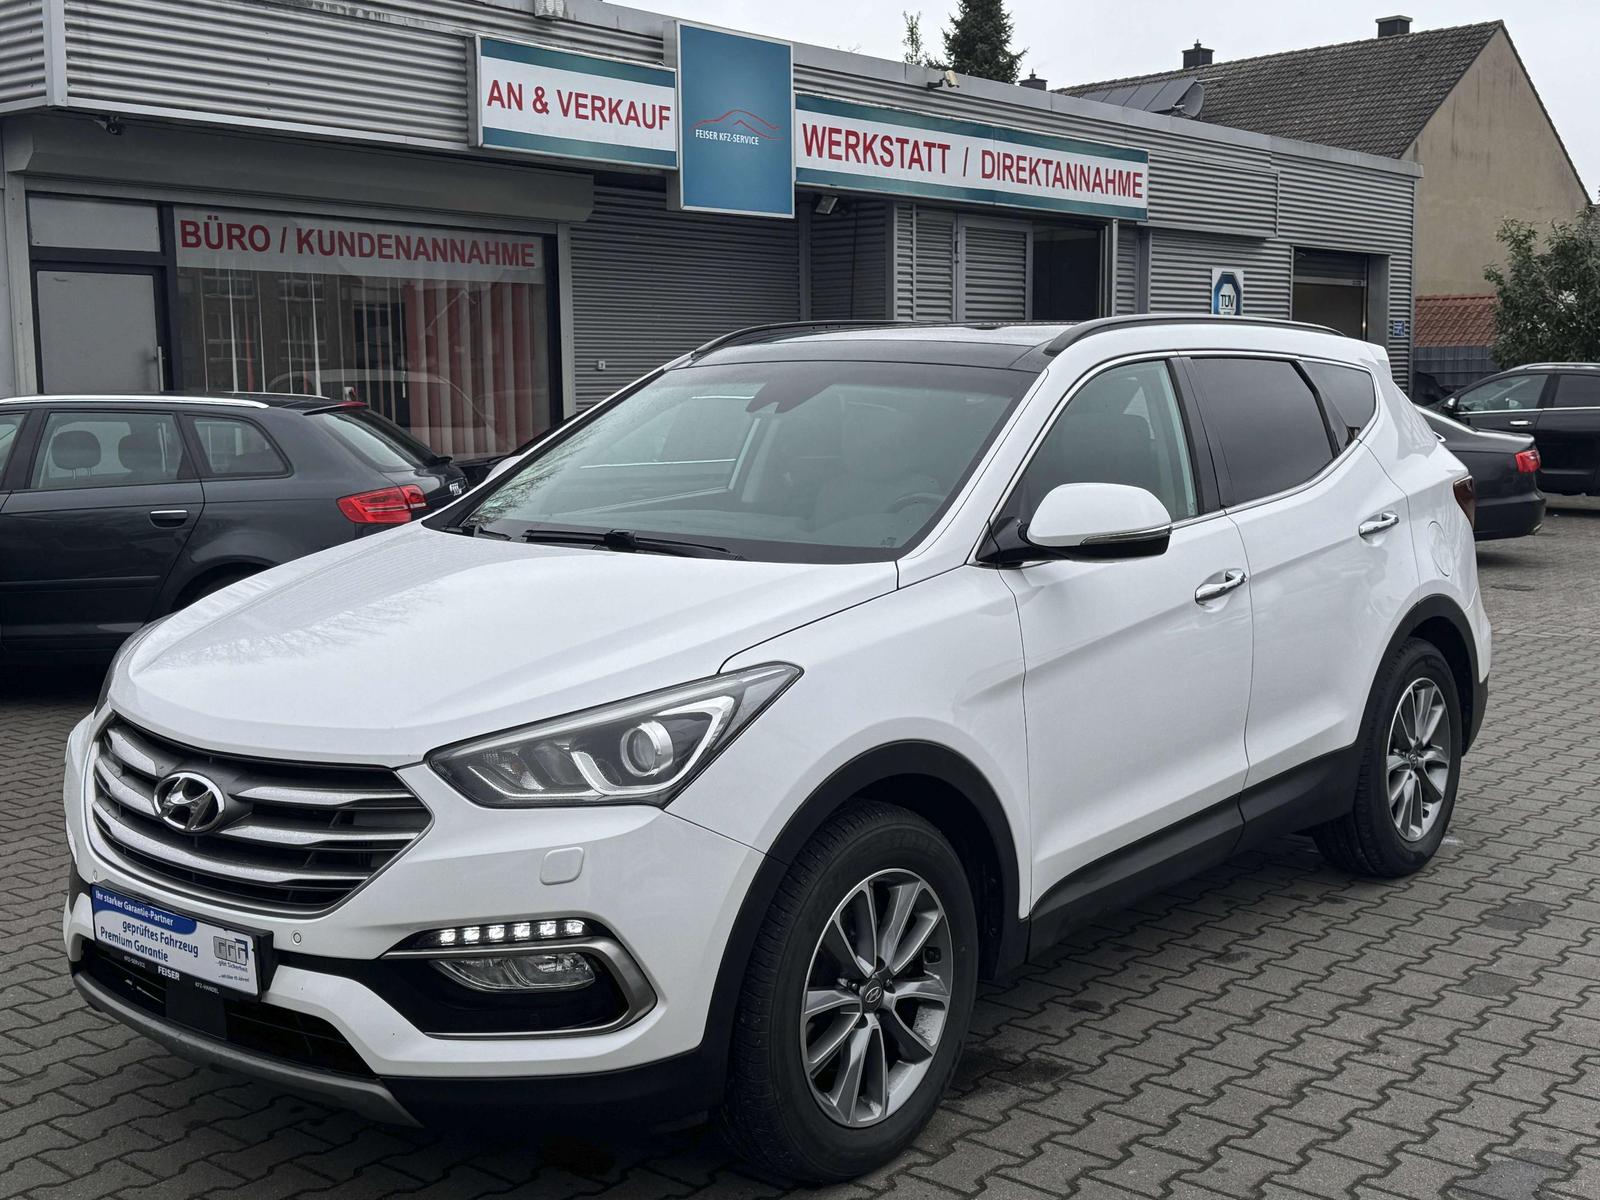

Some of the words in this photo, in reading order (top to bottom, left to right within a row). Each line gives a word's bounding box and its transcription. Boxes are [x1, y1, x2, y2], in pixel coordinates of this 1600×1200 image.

[487, 79, 523, 111] AN
[532, 86, 550, 115] &
[556, 89, 671, 130] VERKAUF
[695, 129, 718, 141] FEISER
[719, 132, 760, 146] KFZ-SERVICE
[802, 123, 951, 174] WERKSTATT
[963, 146, 969, 177] /
[981, 149, 1143, 199] DIREKTANNAHME
[180, 215, 271, 252] BÜRO
[279, 226, 287, 254] /
[296, 227, 535, 267] KUNDENANNAHME
[95, 890, 104, 901] Ihr
[104, 895, 123, 909] starker
[123, 901, 174, 926] Garantie-Partner
[101, 926, 133, 950] Premium
[134, 940, 169, 962] Garantie
[122, 921, 159, 942] geprüftes
[160, 932, 199, 958] Fahrzeug
[157, 966, 180, 981] FEISER
